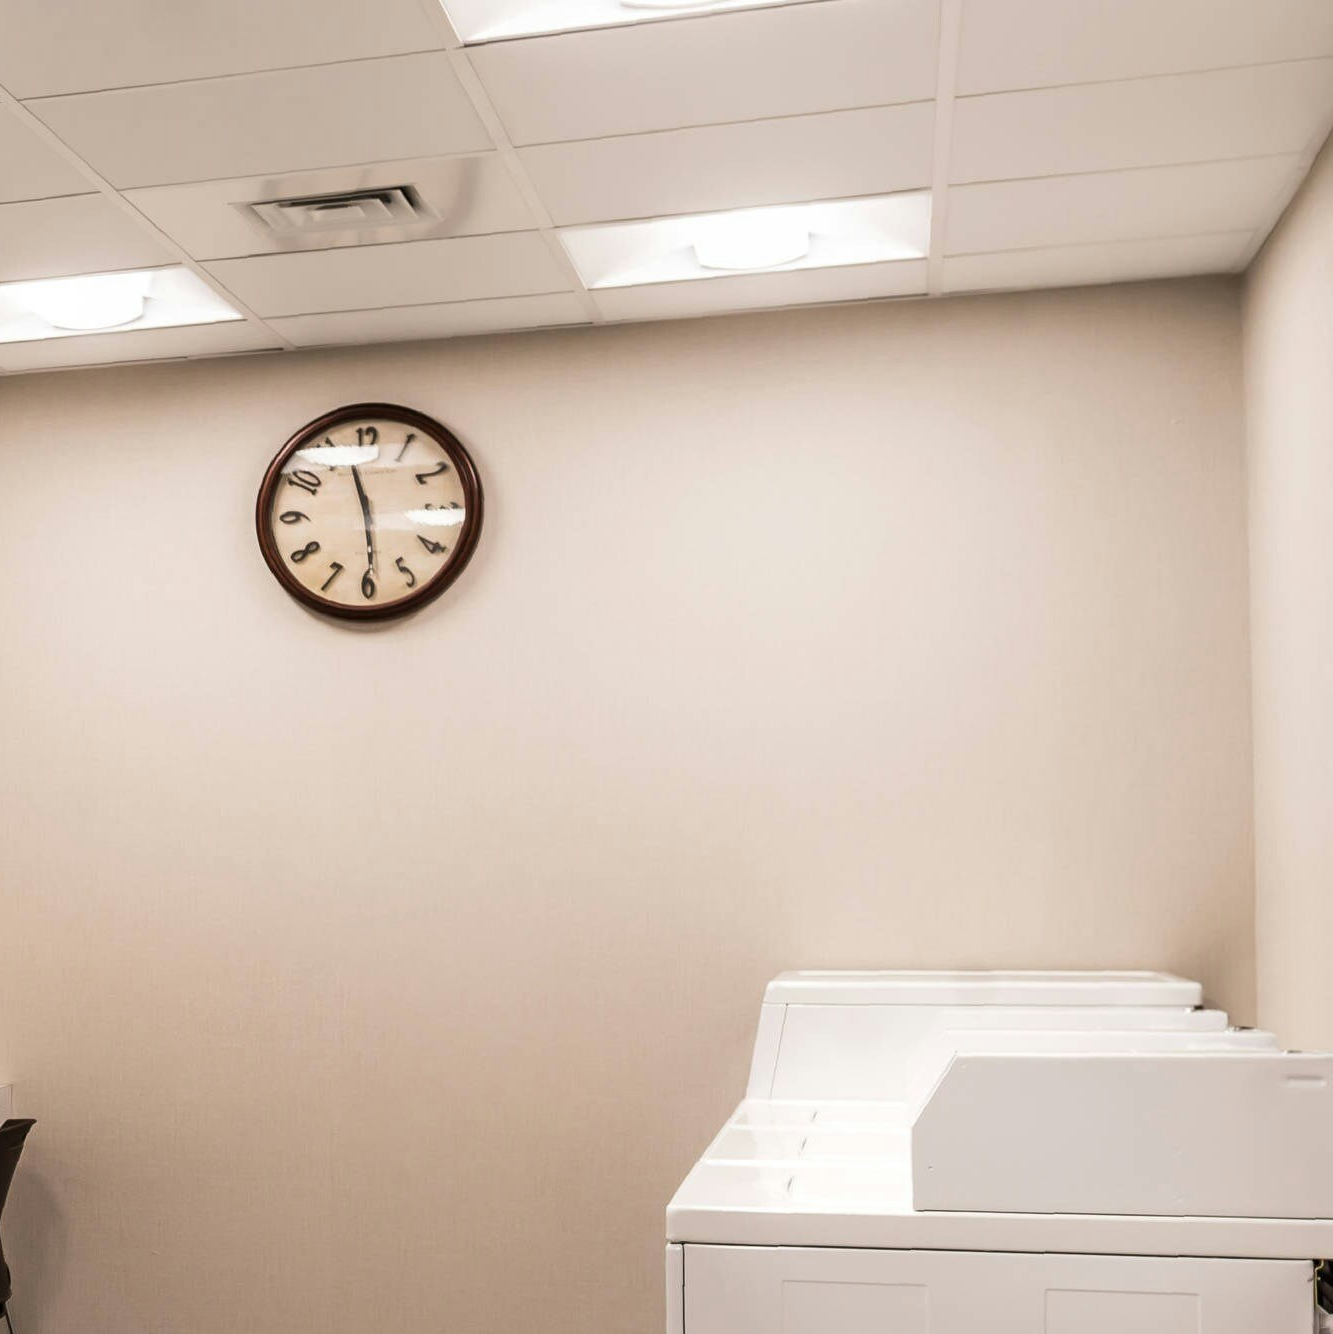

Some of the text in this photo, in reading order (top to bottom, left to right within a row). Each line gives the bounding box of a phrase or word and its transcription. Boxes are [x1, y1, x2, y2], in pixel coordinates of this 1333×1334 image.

[395, 434, 416, 462] 1
[288, 470, 322, 496] 10
[415, 462, 448, 485] 2
[279, 511, 310, 525] 9
[290, 541, 320, 563] 8
[417, 535, 446, 554] 4
[321, 562, 344, 591] 7
[361, 568, 375, 599] 6
[396, 557, 415, 588] 5
